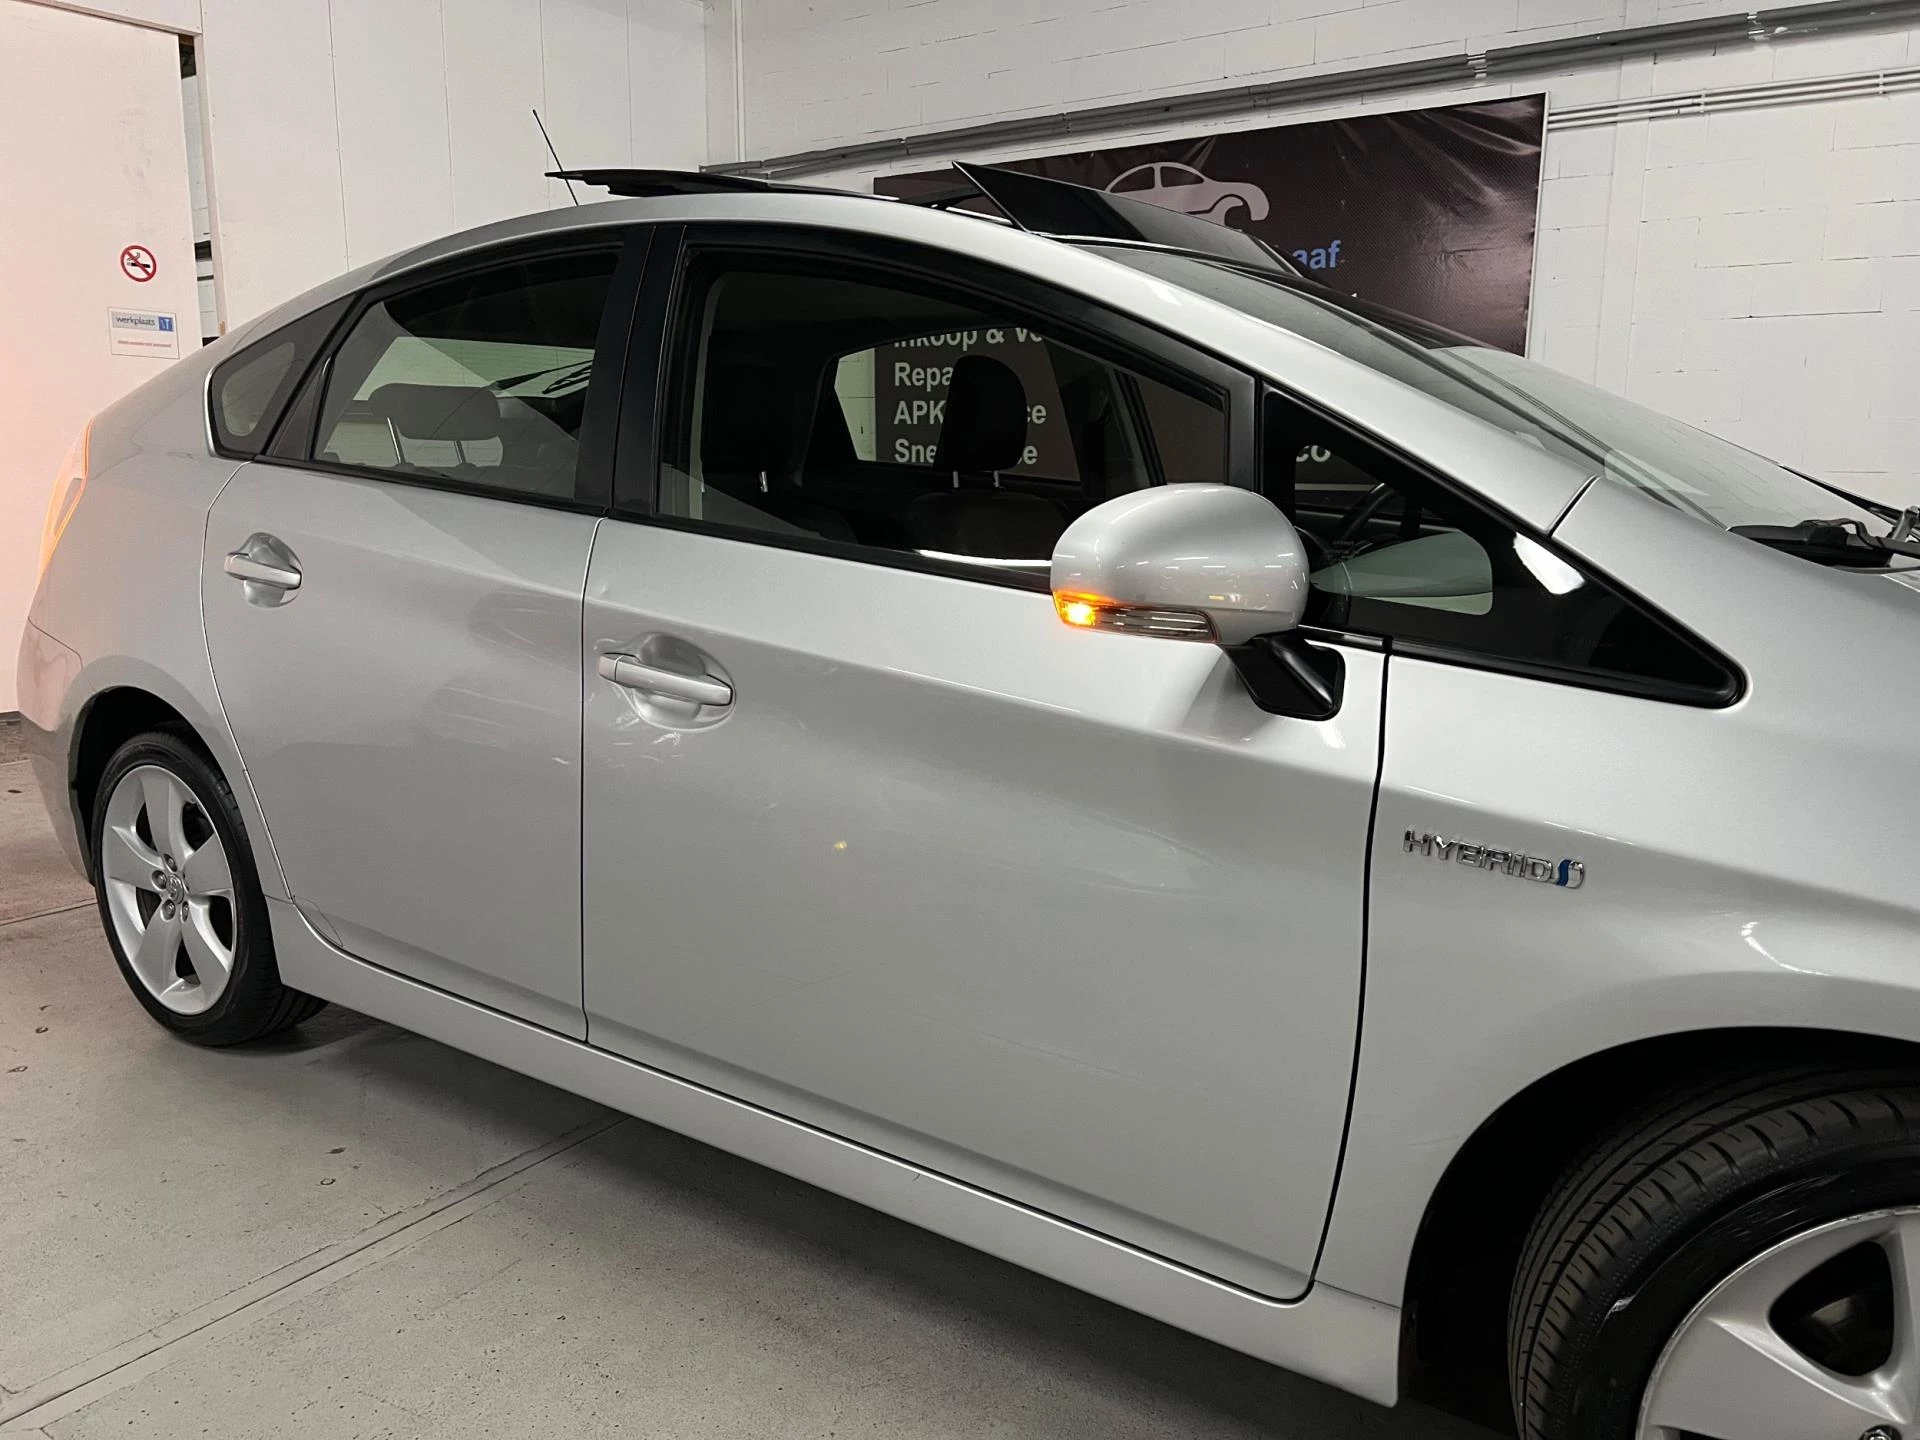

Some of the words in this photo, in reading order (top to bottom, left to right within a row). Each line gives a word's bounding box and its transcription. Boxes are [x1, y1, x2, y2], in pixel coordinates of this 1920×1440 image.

[1292, 240, 1341, 270] aaf
[895, 362, 954, 392] Repa
[893, 400, 947, 425] APK
[894, 438, 938, 464] Sne
[1402, 829, 1553, 883] HYBRID
